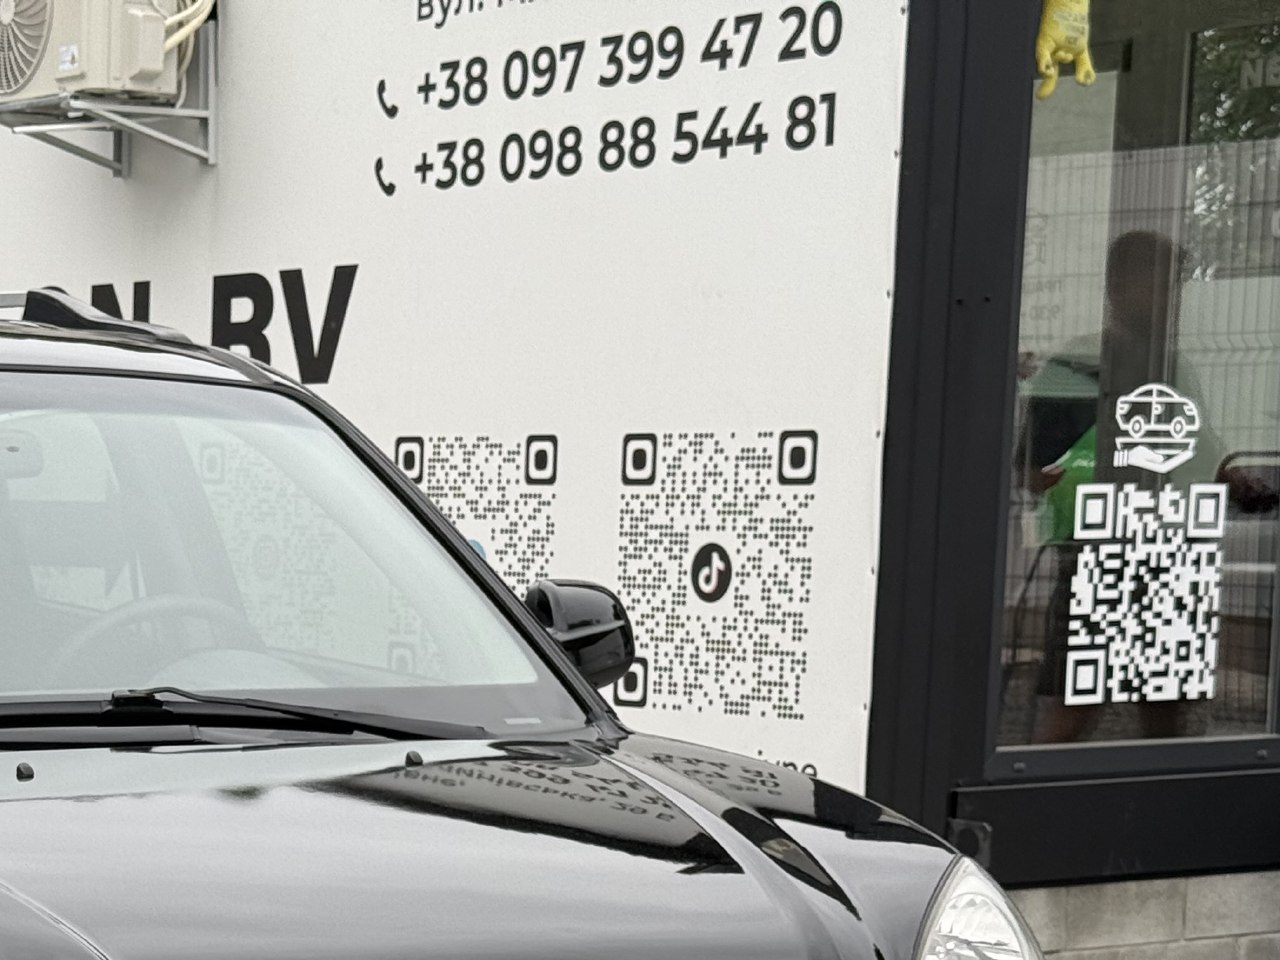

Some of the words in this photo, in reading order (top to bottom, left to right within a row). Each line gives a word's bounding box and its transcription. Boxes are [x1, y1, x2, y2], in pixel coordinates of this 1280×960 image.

[417, 56, 488, 110] +38
[503, 40, 586, 100] 097
[597, 25, 685, 88] 399
[700, 12, 763, 71] 47
[778, 0, 843, 63] 20
[414, 137, 485, 190] +38
[500, 125, 583, 183] 098
[598, 116, 656, 172] 88
[671, 101, 769, 165] 544
[785, 92, 837, 151] 81
[211, 264, 359, 385] RV
